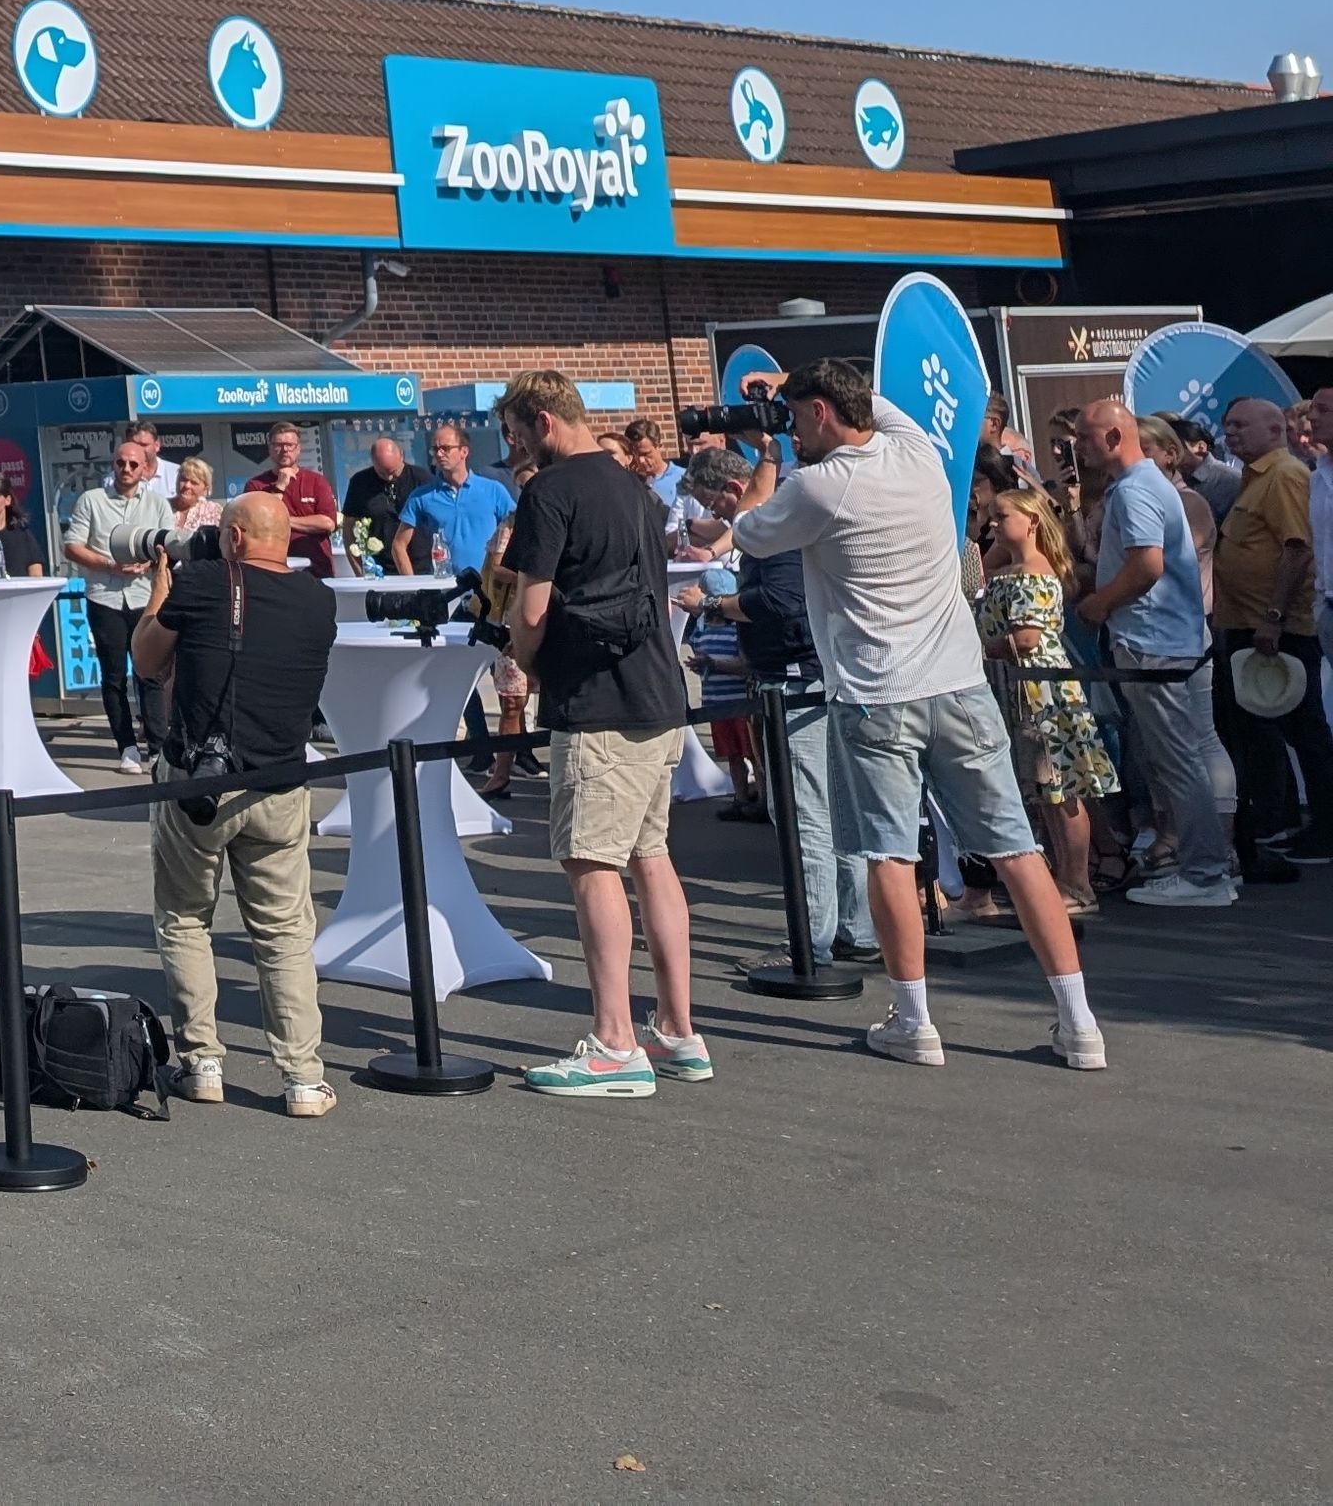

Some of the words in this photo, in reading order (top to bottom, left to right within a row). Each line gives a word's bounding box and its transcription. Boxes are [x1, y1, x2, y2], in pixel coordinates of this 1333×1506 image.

[433, 124, 639, 212] ZooRoyal
[217, 385, 266, 406] ZooRoyal
[275, 382, 348, 405] Waschsalon
